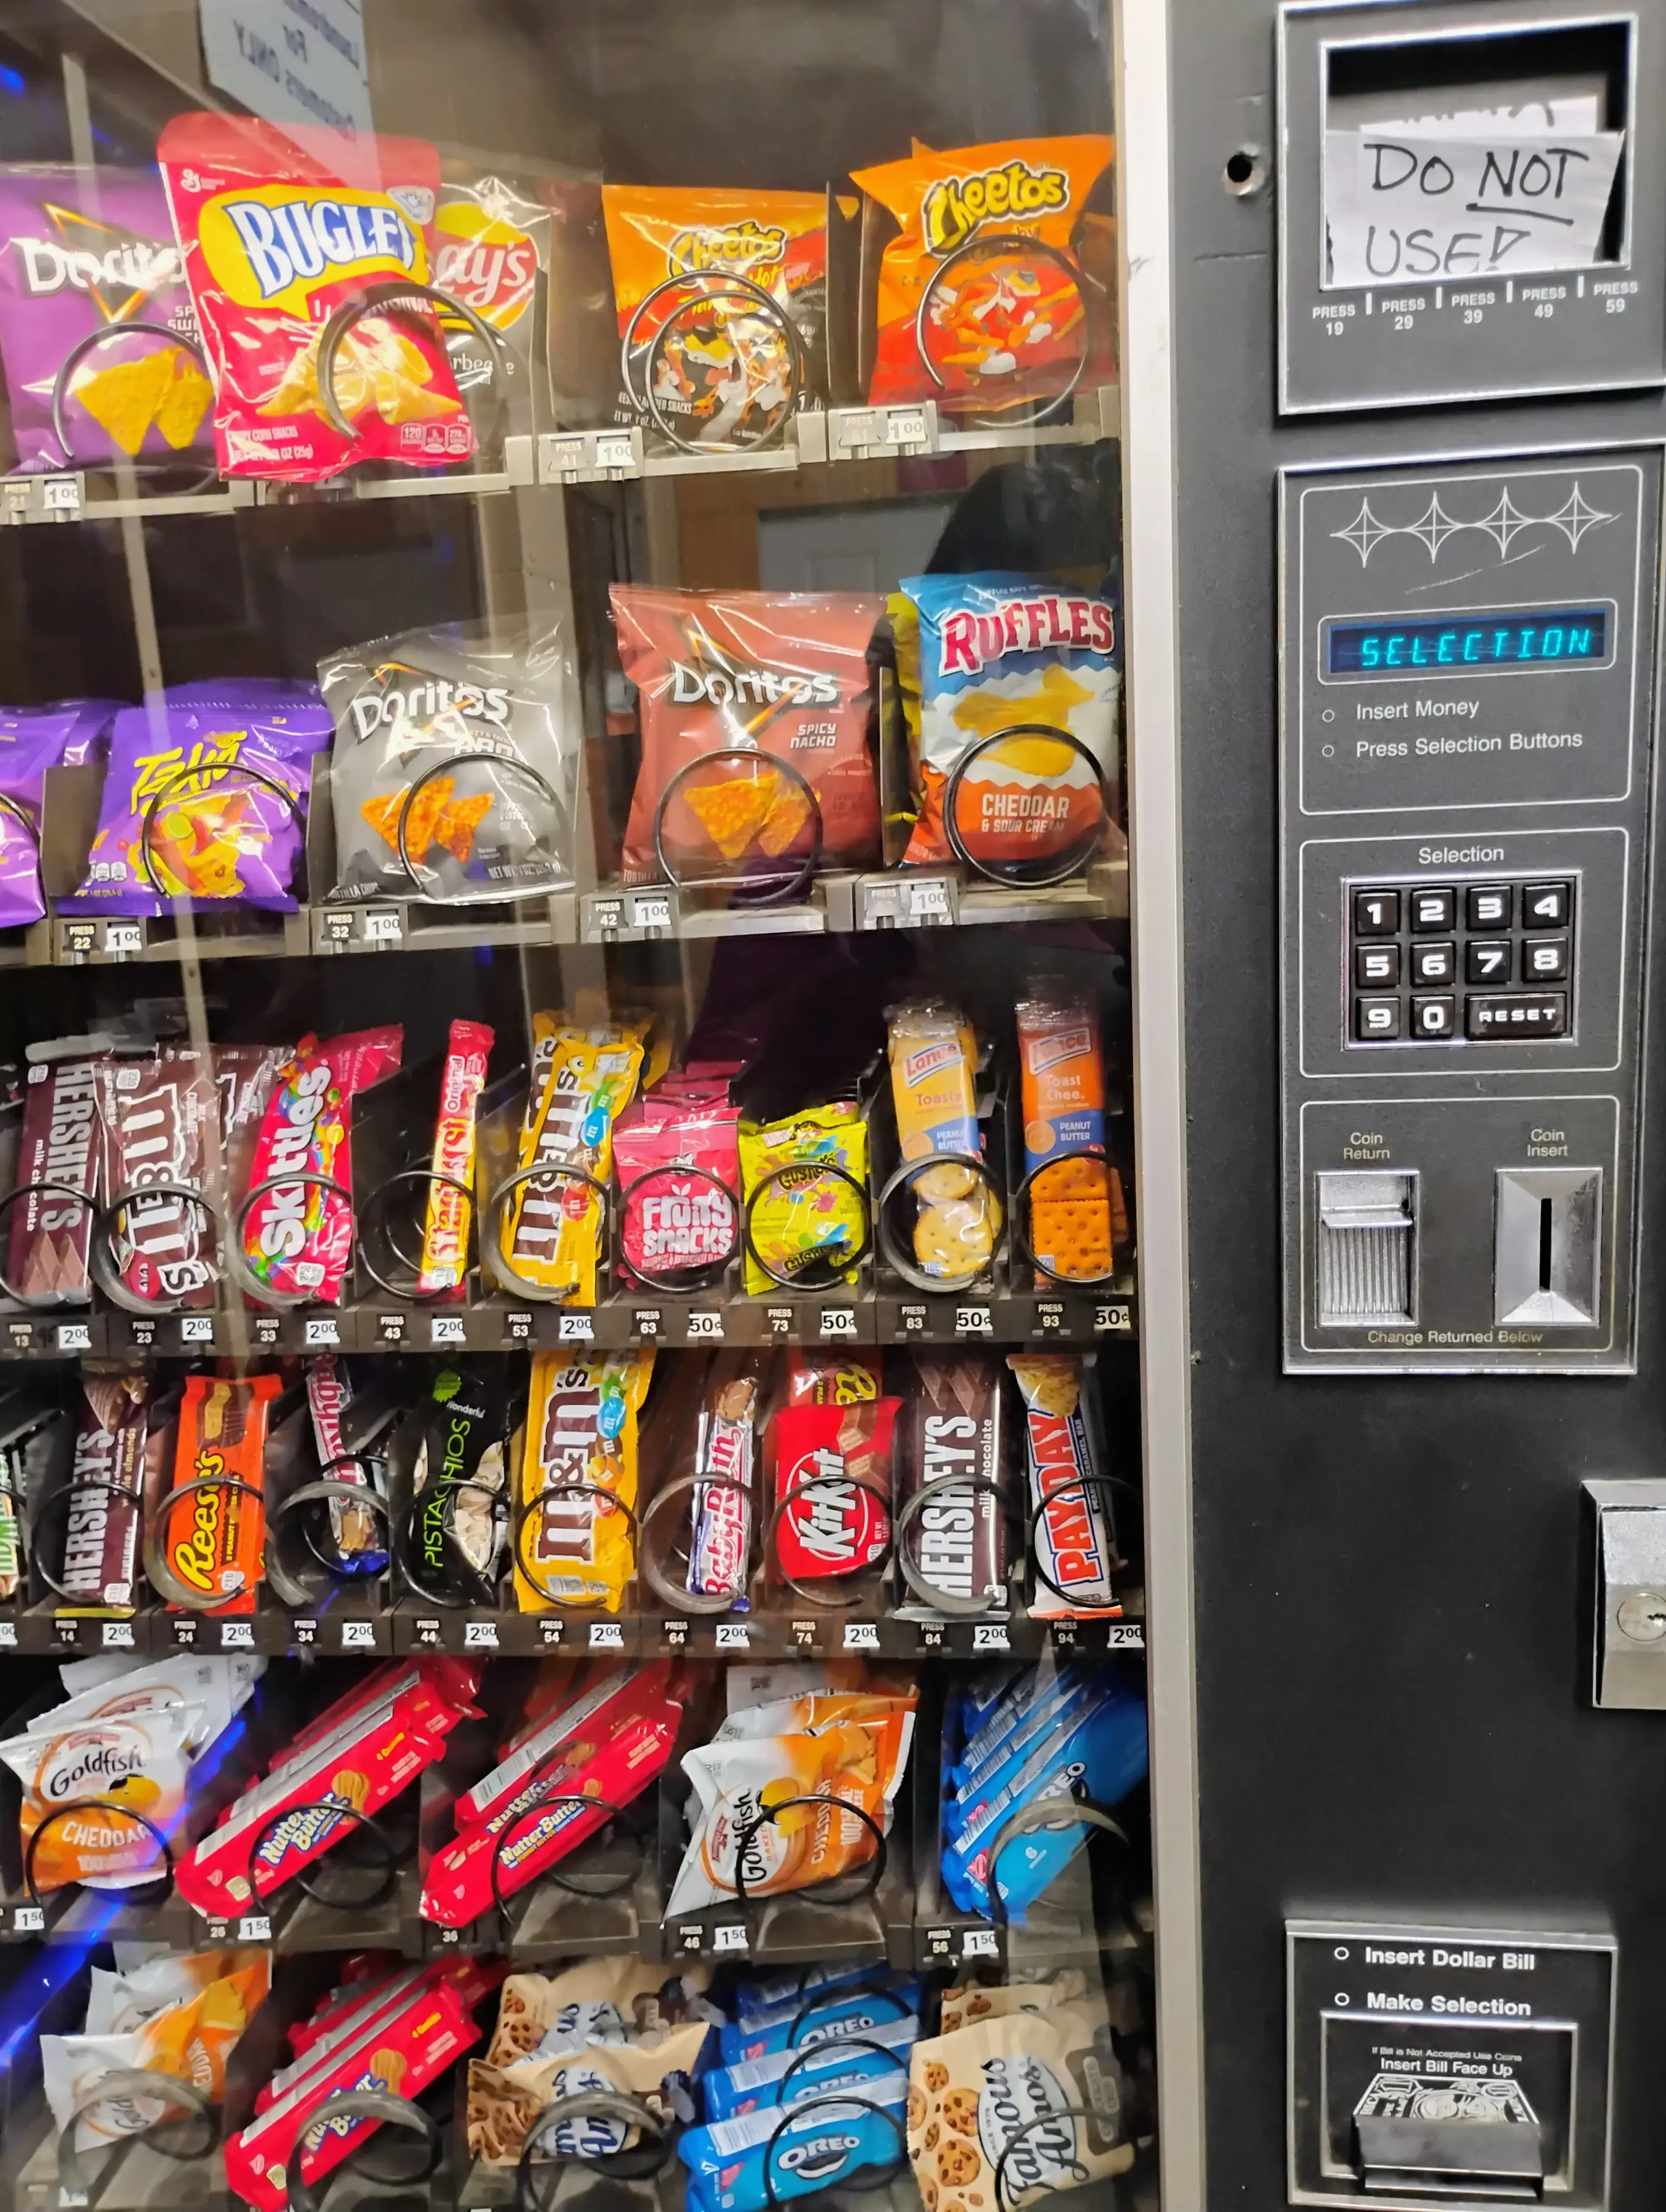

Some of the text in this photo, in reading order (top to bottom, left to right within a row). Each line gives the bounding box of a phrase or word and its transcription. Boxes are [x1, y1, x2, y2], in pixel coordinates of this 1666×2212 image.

[1363, 144, 1590, 198] DO NOT
[925, 162, 1068, 255] Cheetos
[671, 221, 785, 288] Cheetos
[435, 241, 530, 307] ay's
[1522, 286, 1566, 301] PRESS
[1594, 281, 1638, 296] PRESS
[1382, 298, 1425, 313] PRESS
[1452, 292, 1495, 307] PRESS
[1605, 298, 1626, 313] 59
[1312, 304, 1355, 318] PRESS
[1464, 309, 1483, 325] 39
[1534, 304, 1554, 319] 49
[1325, 321, 1344, 337] 19
[1394, 315, 1413, 331] 29
[555, 441, 582, 452] PRESS
[561, 454, 576, 466] 41
[9, 496, 25, 509] 21
[941, 596, 1113, 673] RUFFLES
[1362, 629, 1591, 667] SELECTION
[670, 659, 838, 705] Doritos
[352, 681, 510, 741] Doritos
[1356, 700, 1479, 721] Insert Money
[798, 723, 836, 736] SPICY
[790, 736, 836, 748] NACHO
[1356, 732, 1584, 758] Press Selection Buttons
[982, 794, 1069, 816] CHEDDAR
[982, 818, 1064, 832] & SOUR CREAM
[1418, 845, 1505, 865] Selection
[872, 888, 896, 898] PRESS
[595, 902, 620, 912] PRESS
[1367, 895, 1559, 924] 1 2 3 4
[328, 914, 353, 925] PRESS
[600, 914, 617, 927] 42
[332, 925, 349, 938] 32
[74, 937, 91, 950] 22
[1365, 949, 1559, 978] 5 6 7 8
[1367, 1005, 1557, 1030] 9 0 RESET
[446, 1056, 465, 1111] Original
[1046, 1075, 1081, 1086] Toast
[915, 1091, 962, 1107] Toasty
[1060, 1122, 1091, 1131] PEANUT
[1060, 1132, 1090, 1141] BUTTER
[1350, 1131, 1383, 1146] Coin
[1530, 1128, 1565, 1142] Coin
[41, 1065, 95, 1230] HERSHEY'S
[1343, 1147, 1391, 1161] Return
[1527, 1143, 1568, 1158] Insert
[26, 1139, 43, 1232] milk chcolate
[636, 1310, 660, 1321] PRESS
[768, 1308, 792, 1318] PRESS
[901, 1306, 926, 1316] PRESS
[1038, 1303, 1063, 1314] PRESS
[381, 1315, 403, 1326] PRESS
[509, 1313, 531, 1323] PRESS
[906, 1317, 922, 1329] 83
[1042, 1315, 1060, 1327] 93
[384, 1327, 401, 1339] 43
[512, 1325, 529, 1336] 53
[640, 1322, 657, 1334] 63
[772, 1320, 789, 1332] 73
[15, 1336, 28, 1347] 13
[137, 1332, 152, 1344] 23
[260, 1330, 276, 1342] 33
[1367, 1329, 1543, 1346] Change Returned Below
[446, 1400, 486, 1419] Wonderful
[980, 1418, 993, 1518] milk hocolate
[424, 1418, 471, 1567] PISTACHIOS
[1029, 1410, 1103, 1586] PAYDAY
[705, 1428, 744, 1595] BabyRth
[540, 1620, 563, 1629] PRESS
[665, 1621, 688, 1630] PRESS
[792, 1621, 816, 1631] PRESS
[921, 1622, 945, 1631] PRESS
[61, 1631, 74, 1642] 14
[178, 1632, 194, 1643] 24
[298, 1630, 313, 1642] 34
[420, 1630, 437, 1642] 44
[544, 1631, 560, 1643] 54
[669, 1632, 685, 1643] 64
[797, 1632, 812, 1644] 74
[925, 1633, 941, 1645] 84
[1058, 1632, 1075, 1644] 94
[50, 1748, 142, 1797] Goldfish
[61, 1821, 154, 1849] CHEDDAR
[259, 1811, 307, 1865] Nutter
[732, 1789, 767, 1883] Golfish
[500, 1828, 544, 1866] Nutter
[684, 1937, 700, 1949] 46
[933, 1941, 949, 1953] 56
[1365, 1946, 1535, 1971] Insert Dollar Bill
[1367, 1992, 1531, 2016] Make Selection
[800, 2017, 874, 2047] OREO
[1406, 2048, 1423, 2056] Not
[1381, 2057, 1513, 2078] Insert Bill Face Up
[778, 2136, 861, 2170] OREO
